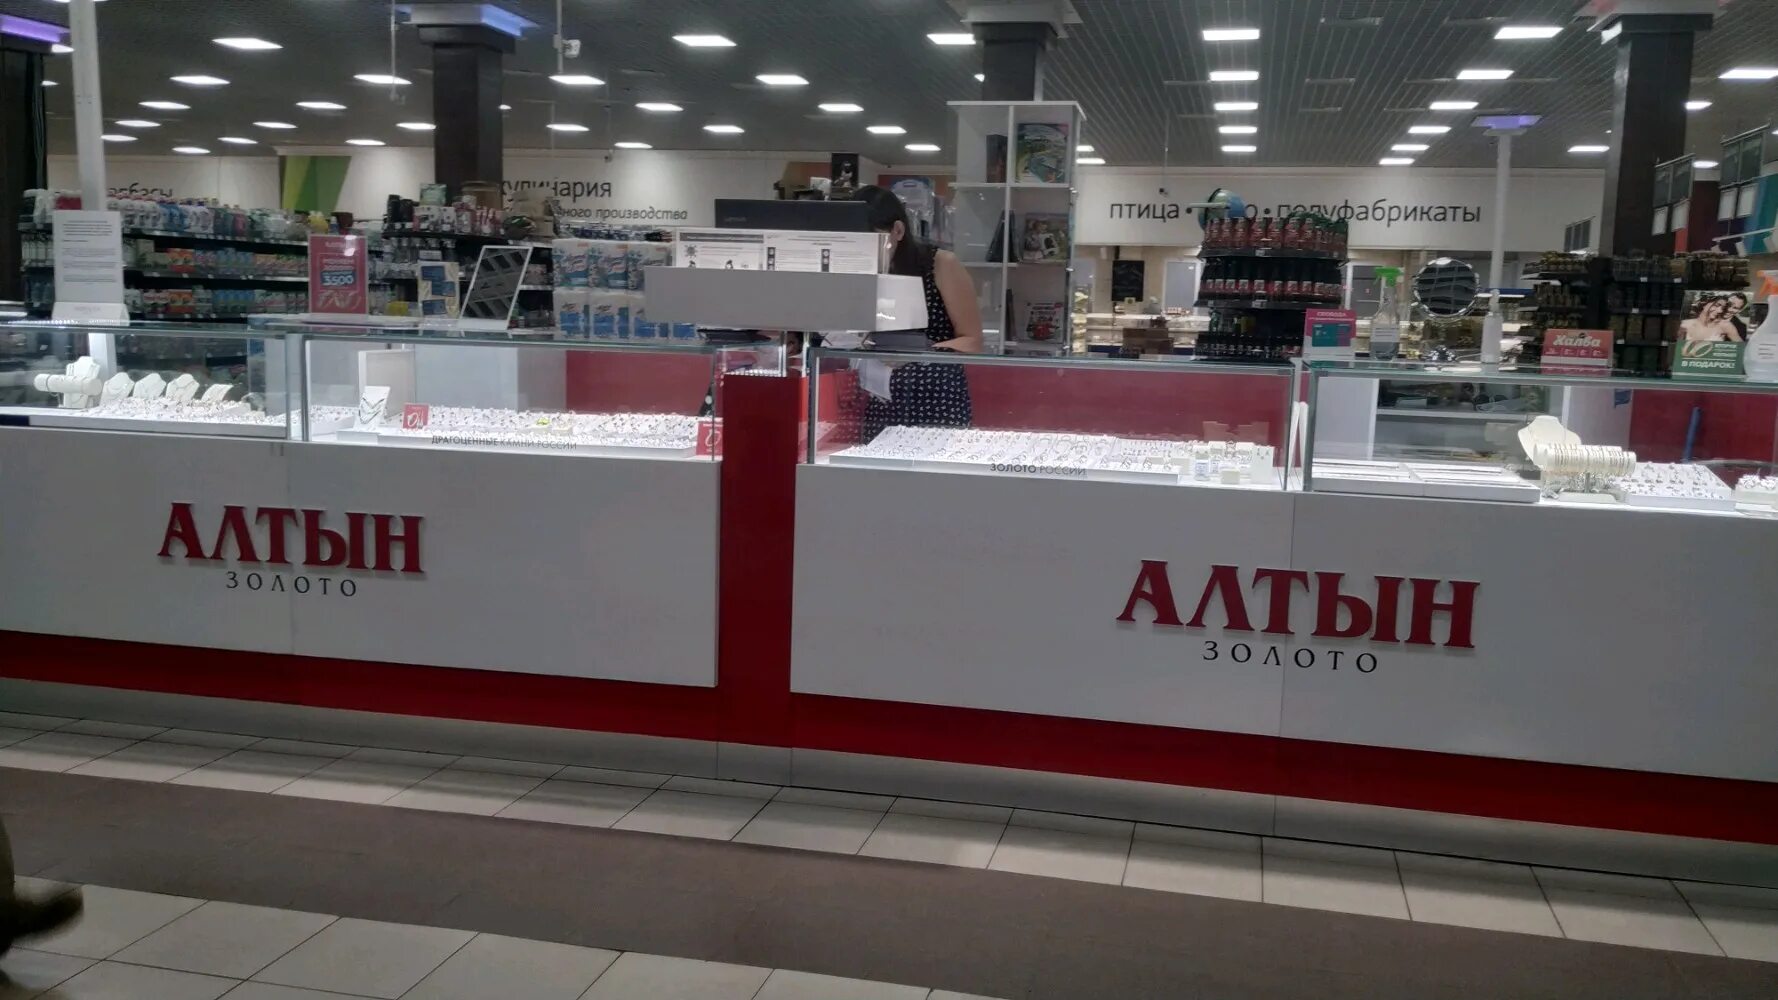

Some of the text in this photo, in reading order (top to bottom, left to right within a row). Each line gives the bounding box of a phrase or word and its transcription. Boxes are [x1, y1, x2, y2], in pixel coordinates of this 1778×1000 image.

[595, 206, 688, 220] производства
[1109, 203, 1180, 222] птица
[1552, 334, 1603, 348] Халва
[1688, 361, 1737, 369] ПОДАРОК!
[431, 435, 577, 450] ДРАГОЦЕННЫЕ КАМНИ РОССИИ
[990, 463, 1087, 476] ЗОЛОТО РОССИИ
[157, 502, 425, 573] АЛТЫН
[225, 570, 357, 598] ЗОЛОТО
[1115, 559, 1481, 649] АЛТЫН
[1202, 640, 1378, 673] ЗОЛОТО
